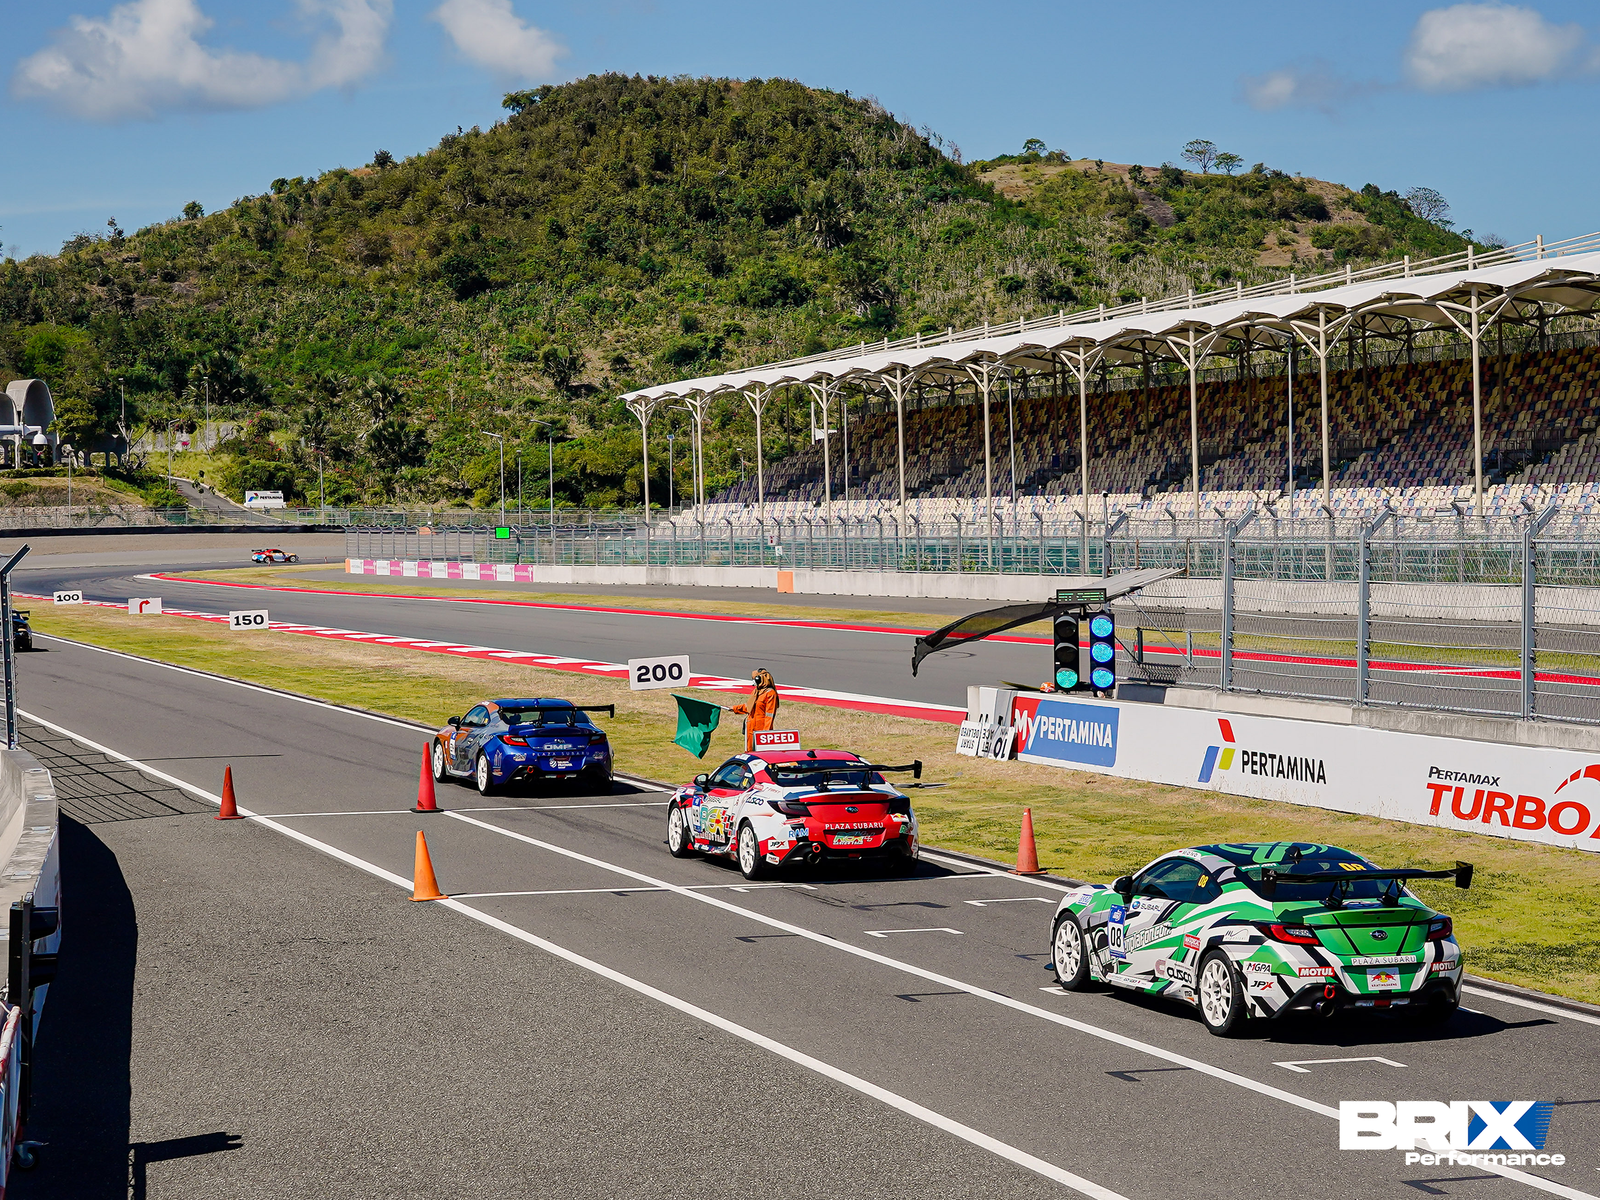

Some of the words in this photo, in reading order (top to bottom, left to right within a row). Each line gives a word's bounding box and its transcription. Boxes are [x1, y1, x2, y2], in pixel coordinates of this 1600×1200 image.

[56, 594, 79, 602] 100
[234, 614, 264, 626] 150
[636, 663, 683, 683] 200
[759, 733, 795, 744] SPEED
[961, 727, 980, 739] DELAYED
[982, 728, 994, 740] ACE
[960, 739, 975, 749] START
[994, 737, 1007, 759] 10
[1241, 749, 1327, 785] PERTAMINA
[1428, 765, 1501, 787] PERTAMAX
[1426, 782, 1591, 836] TURBO
[789, 828, 809, 838] RAM
[1110, 926, 1122, 948] 08
[1382, 956, 1416, 964] SUBARU
[1432, 961, 1456, 971] MOTUL
[1299, 968, 1334, 977] MOTUL
[1250, 980, 1275, 991] JPX
